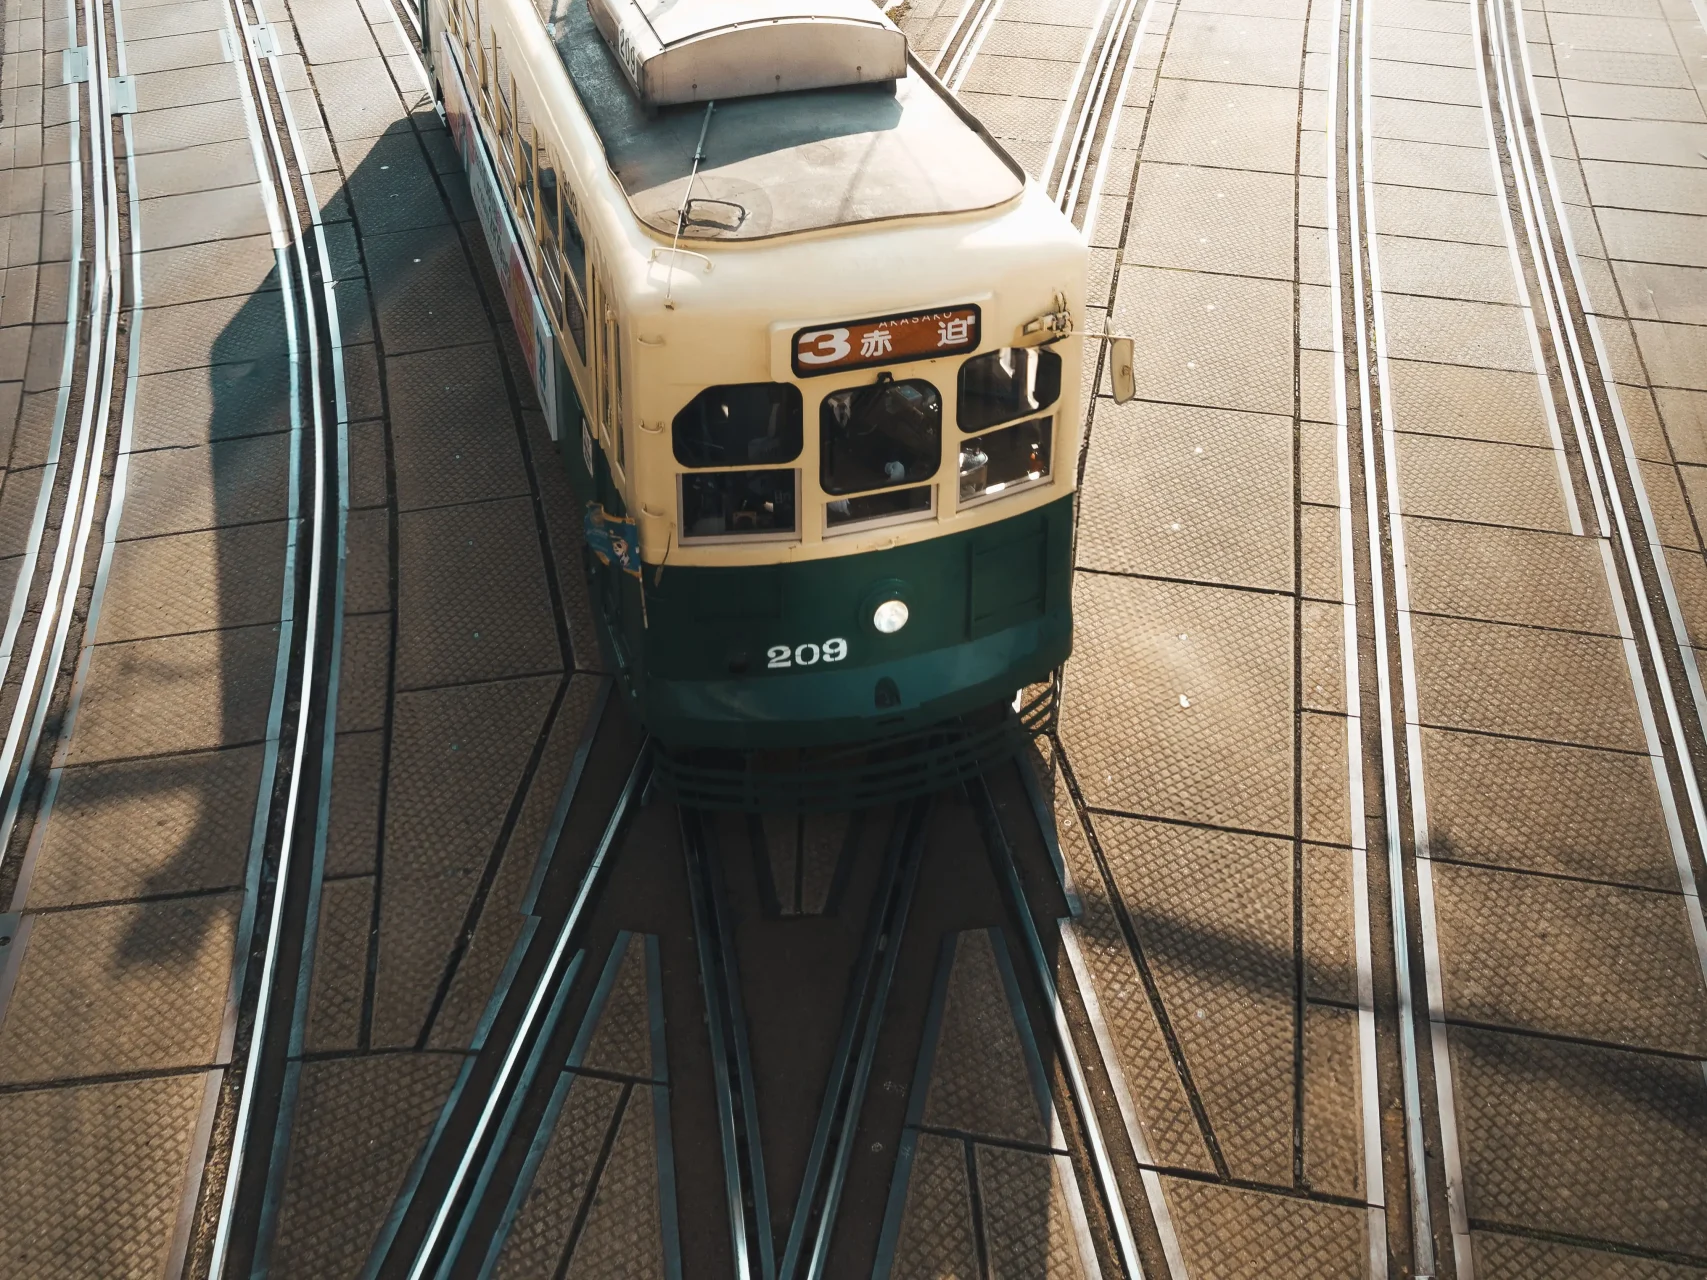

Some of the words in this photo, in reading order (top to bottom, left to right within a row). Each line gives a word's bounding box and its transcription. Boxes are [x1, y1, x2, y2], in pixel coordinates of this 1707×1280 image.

[798, 328, 851, 365] 3
[860, 330, 892, 358] 赤
[937, 318, 969, 347] 迫
[767, 638, 848, 669] 209
